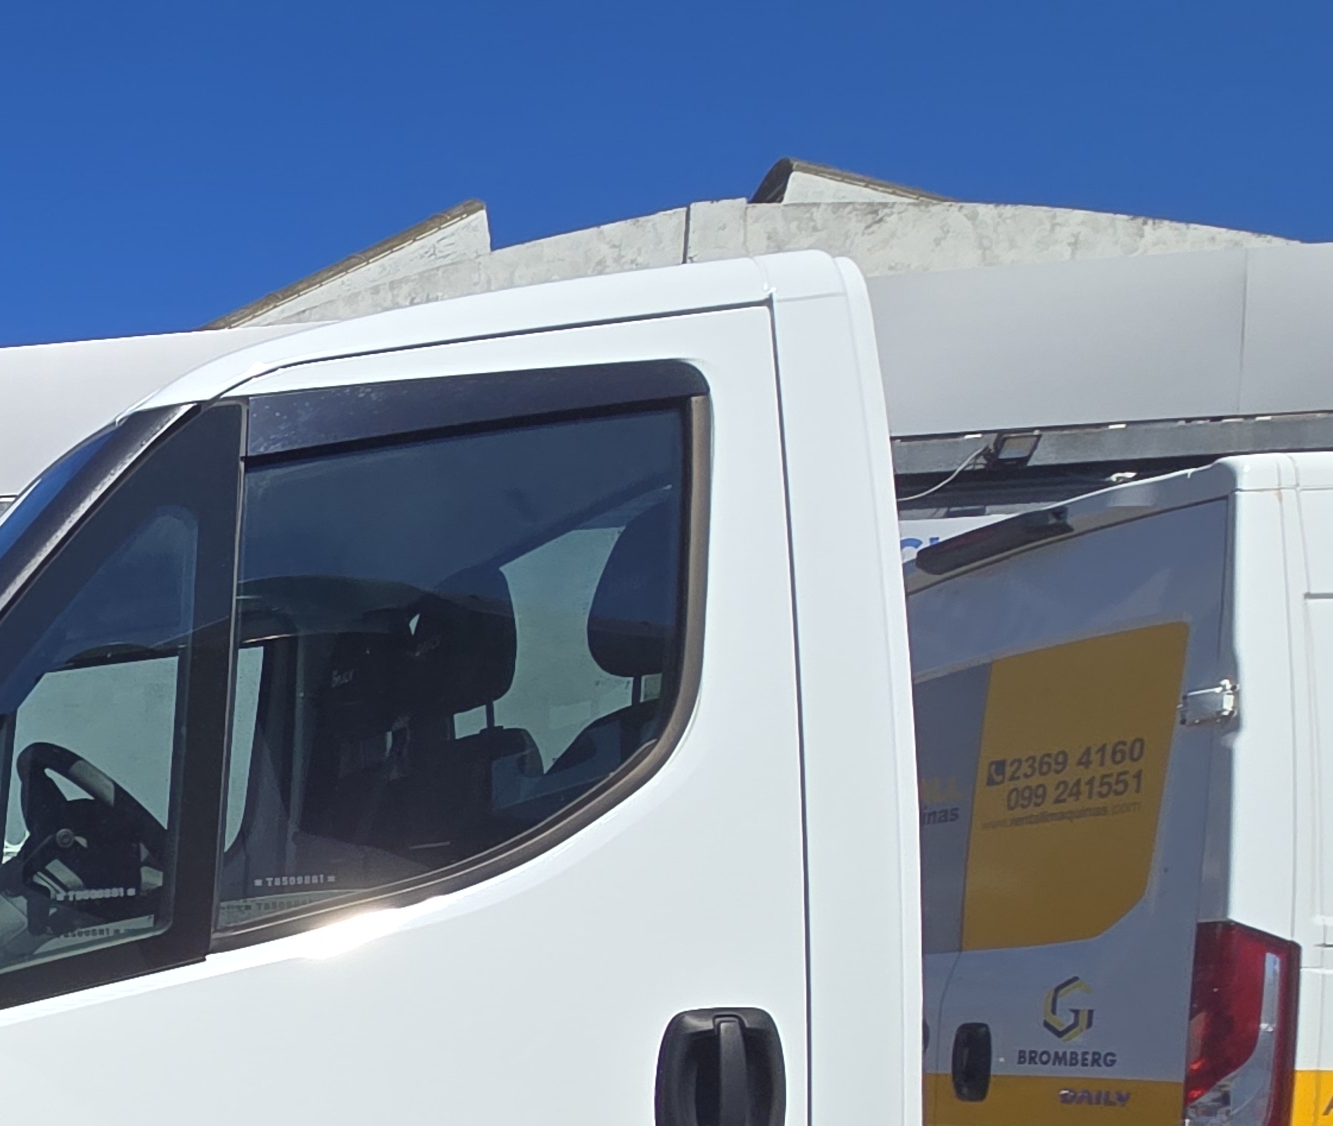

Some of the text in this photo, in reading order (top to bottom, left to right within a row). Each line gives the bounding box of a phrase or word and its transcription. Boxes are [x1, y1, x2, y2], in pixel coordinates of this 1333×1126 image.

[1007, 737, 1146, 782] 2369 4160
[1006, 769, 1144, 811] 099 241551
[1017, 1049, 1117, 1068] BROMBERG
[1059, 1088, 1131, 1107] DAILY
